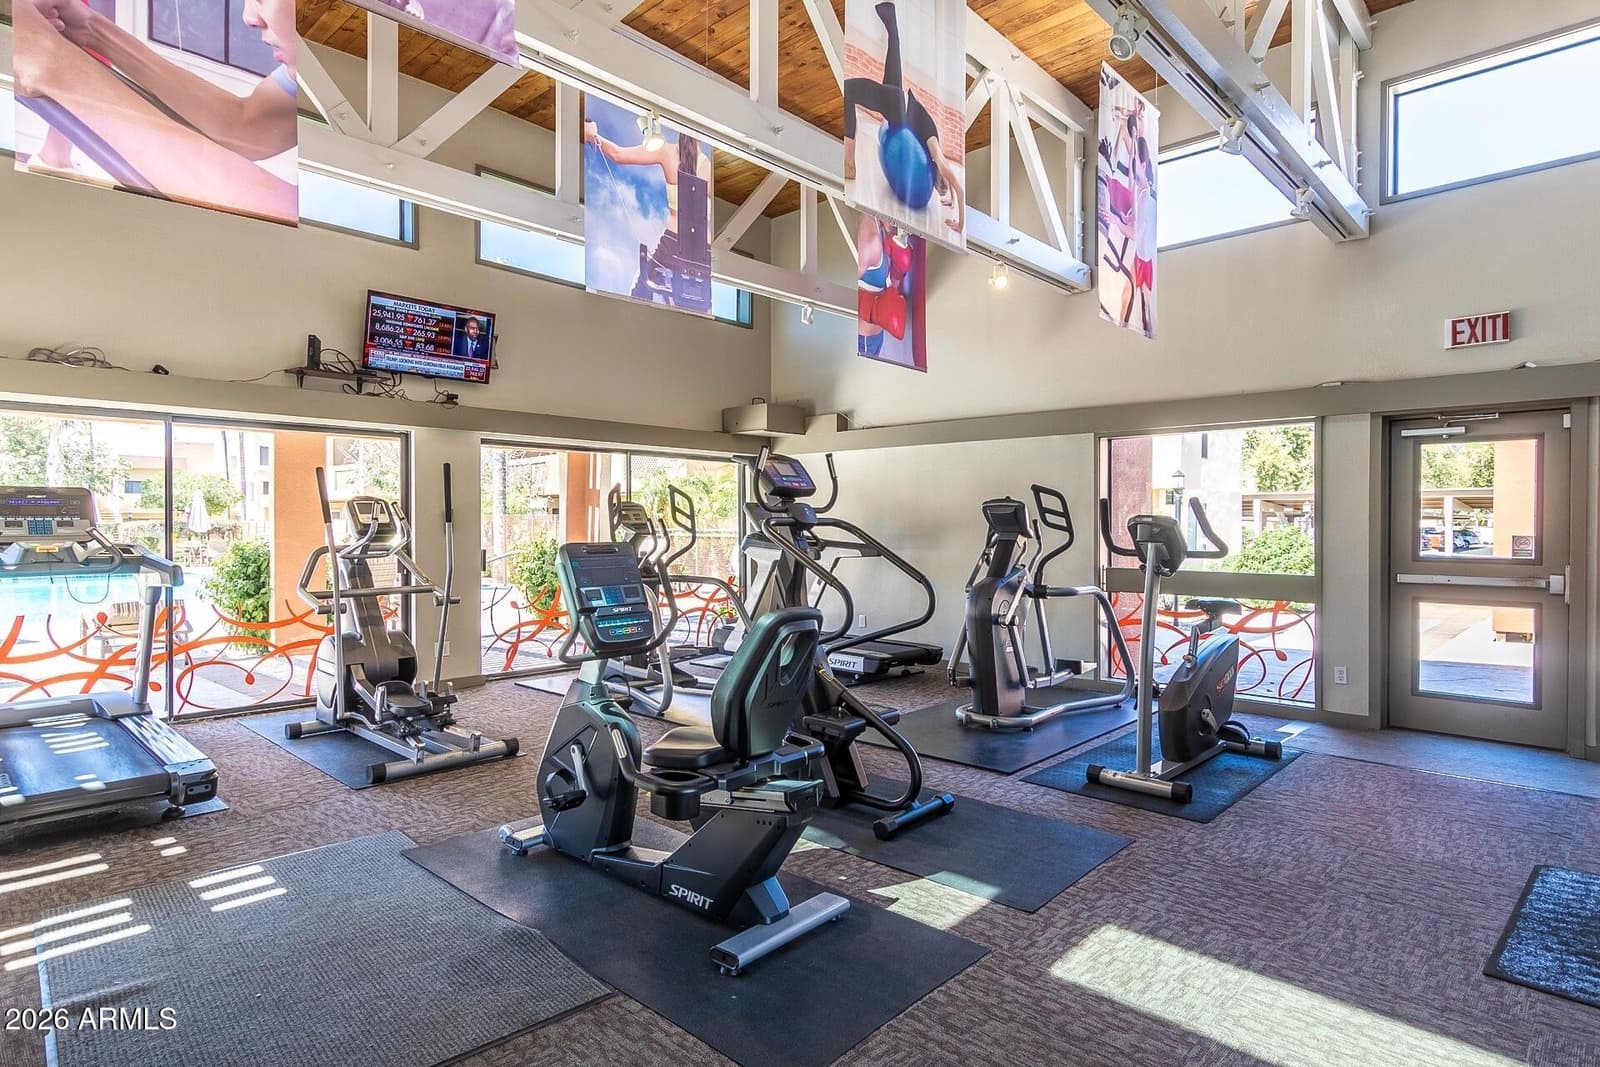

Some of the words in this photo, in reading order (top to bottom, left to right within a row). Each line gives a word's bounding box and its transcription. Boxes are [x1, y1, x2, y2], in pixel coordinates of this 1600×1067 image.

[393, 301, 417, 309] MARKETS
[418, 305, 435, 313] TODAY
[372, 308, 404, 321] 25,941.95
[414, 316, 436, 326] 761.37
[375, 322, 404, 334] 8,686.24
[412, 329, 435, 338] 265.93
[415, 342, 434, 351] 83.68
[828, 657, 857, 668] SPIRIT
[669, 884, 714, 910] SPIRIT
